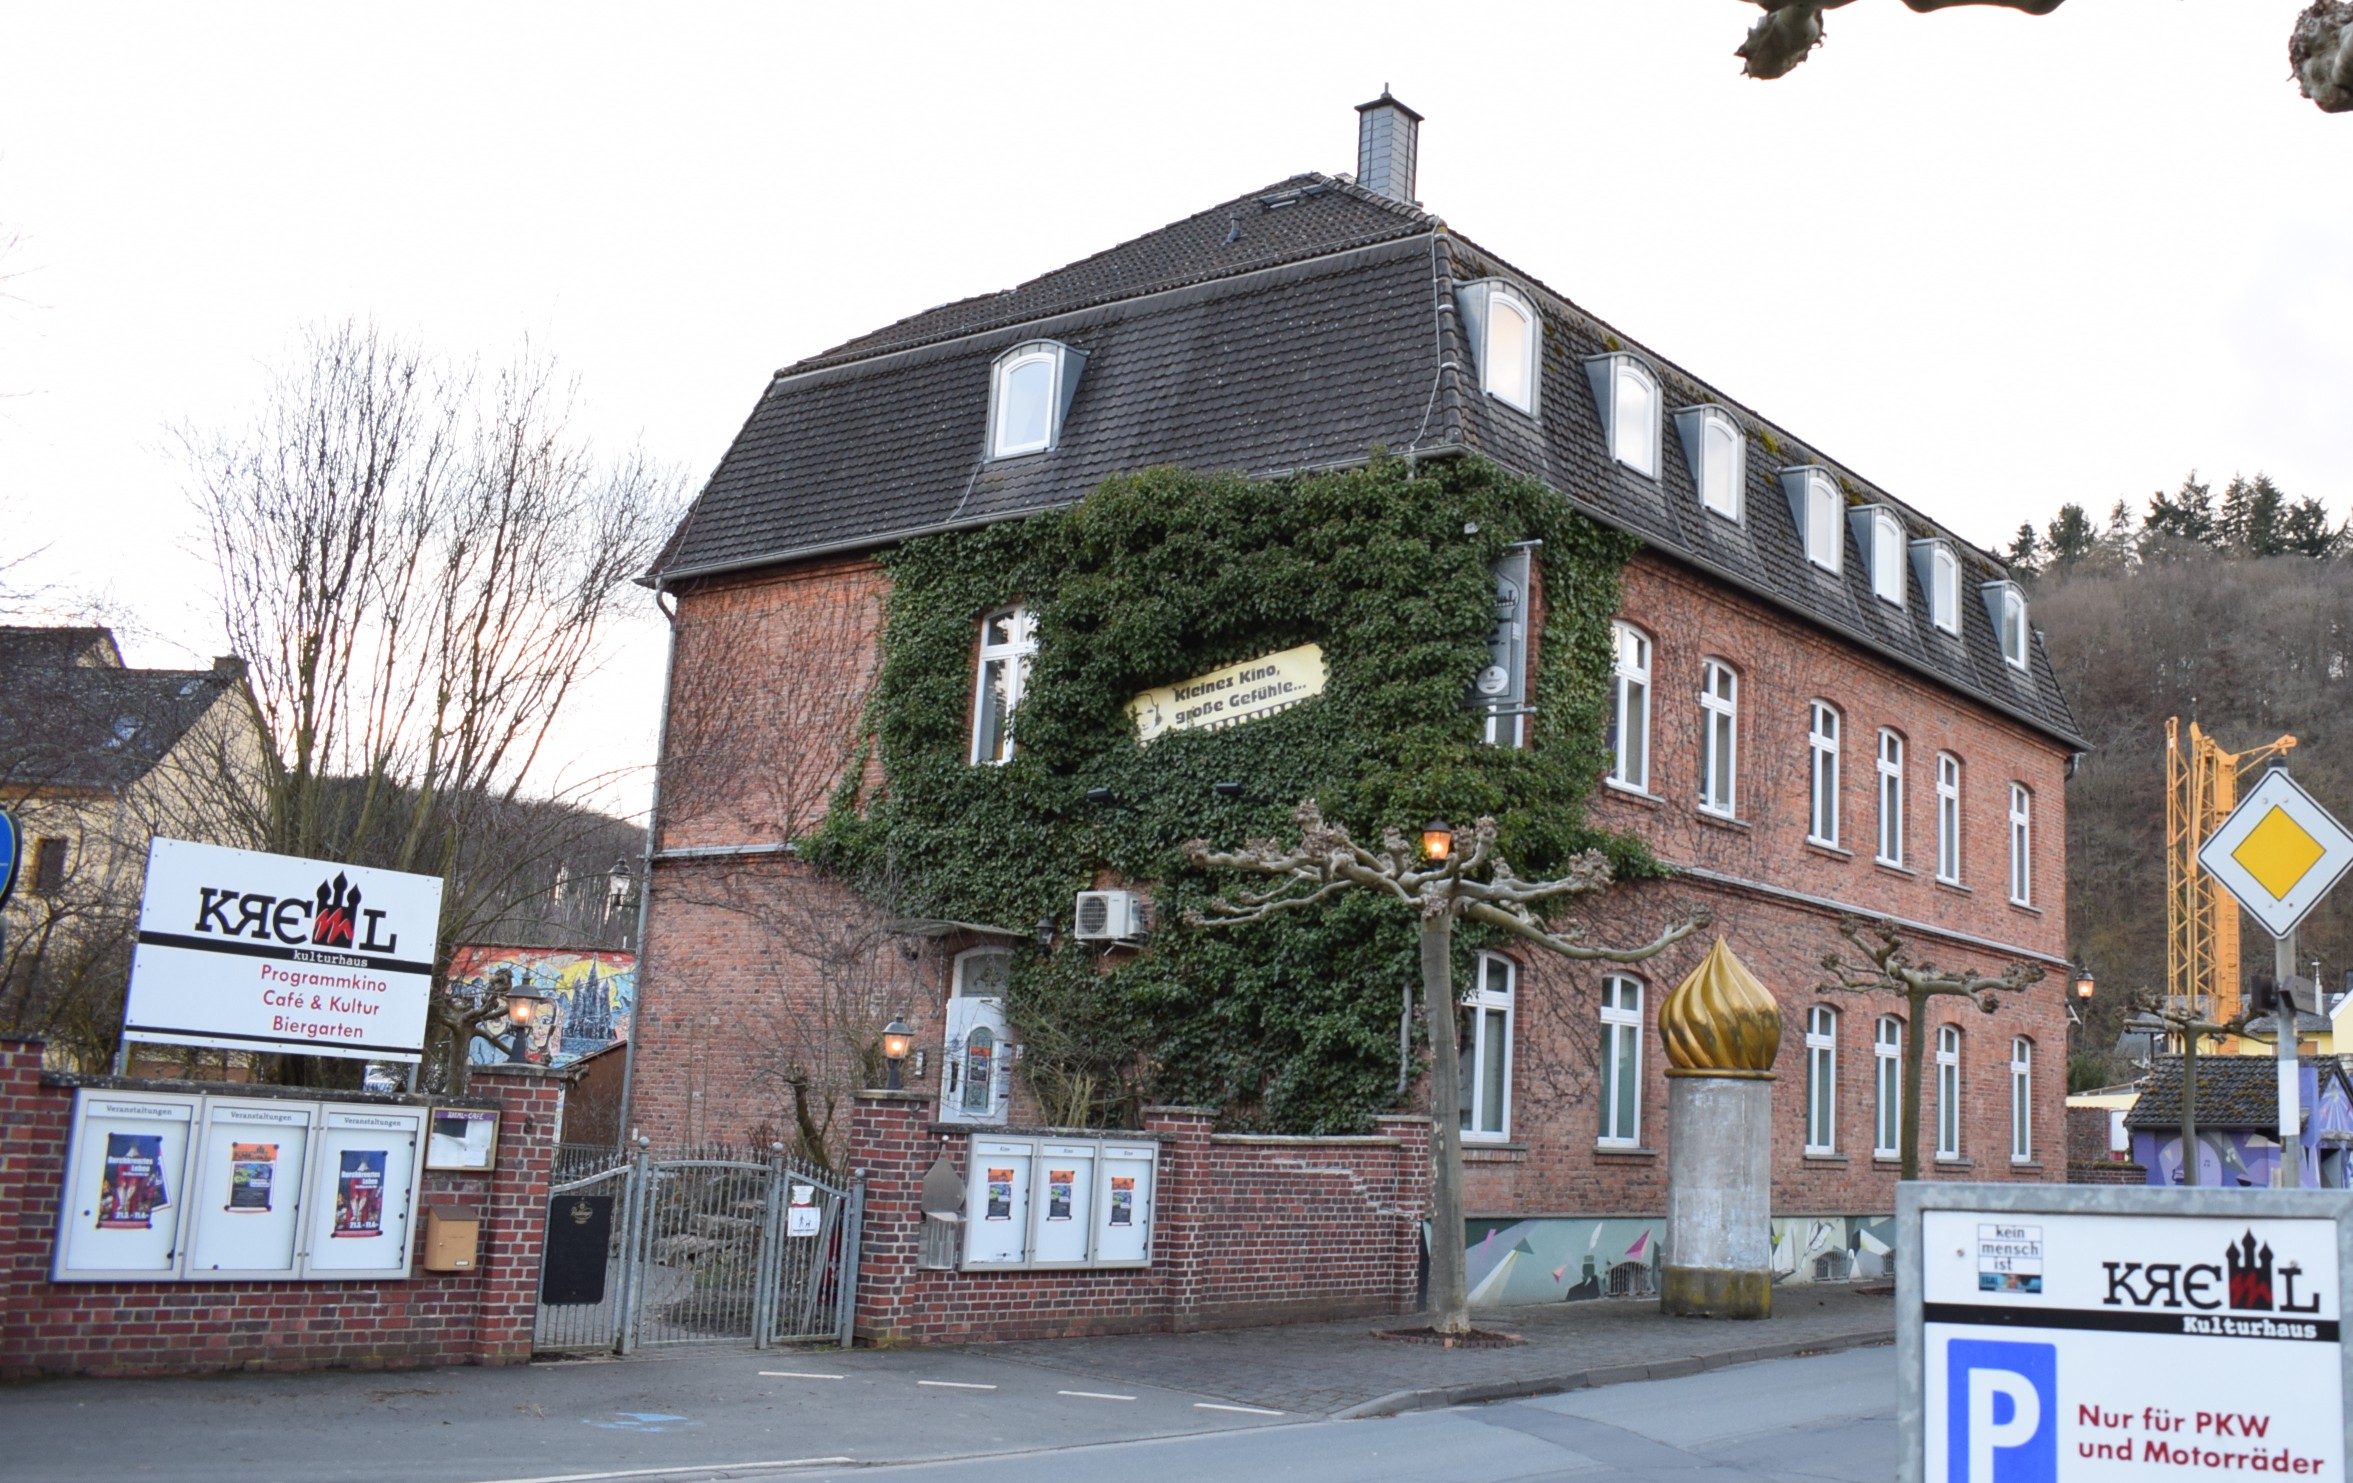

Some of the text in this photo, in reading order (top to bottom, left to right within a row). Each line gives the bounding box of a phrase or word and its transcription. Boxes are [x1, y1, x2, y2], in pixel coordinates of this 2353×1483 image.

[1174, 664, 1281, 702] Kleines Kino,
[1175, 681, 1307, 724] große Gefühle...
[293, 949, 368, 967] kulturhaus
[261, 964, 387, 992] Programmkino
[263, 989, 380, 1015] Café & Kultur
[272, 1015, 363, 1038] Biergarten
[106, 1105, 172, 1116] Veranstaltungen
[231, 1111, 292, 1122] Veranstaltungen
[344, 1117, 401, 1127] Veranstaltungen
[1995, 1224, 2025, 1238] kein
[1981, 1241, 2039, 1256] mensch
[1994, 1256, 2012, 1271] ist
[2182, 1316, 2318, 1339] Kulturhaus
[1968, 1367, 2041, 1483] P
[2079, 1404, 2271, 1438] Nur für PKW
[2079, 1438, 2324, 1475] und Motorräder
